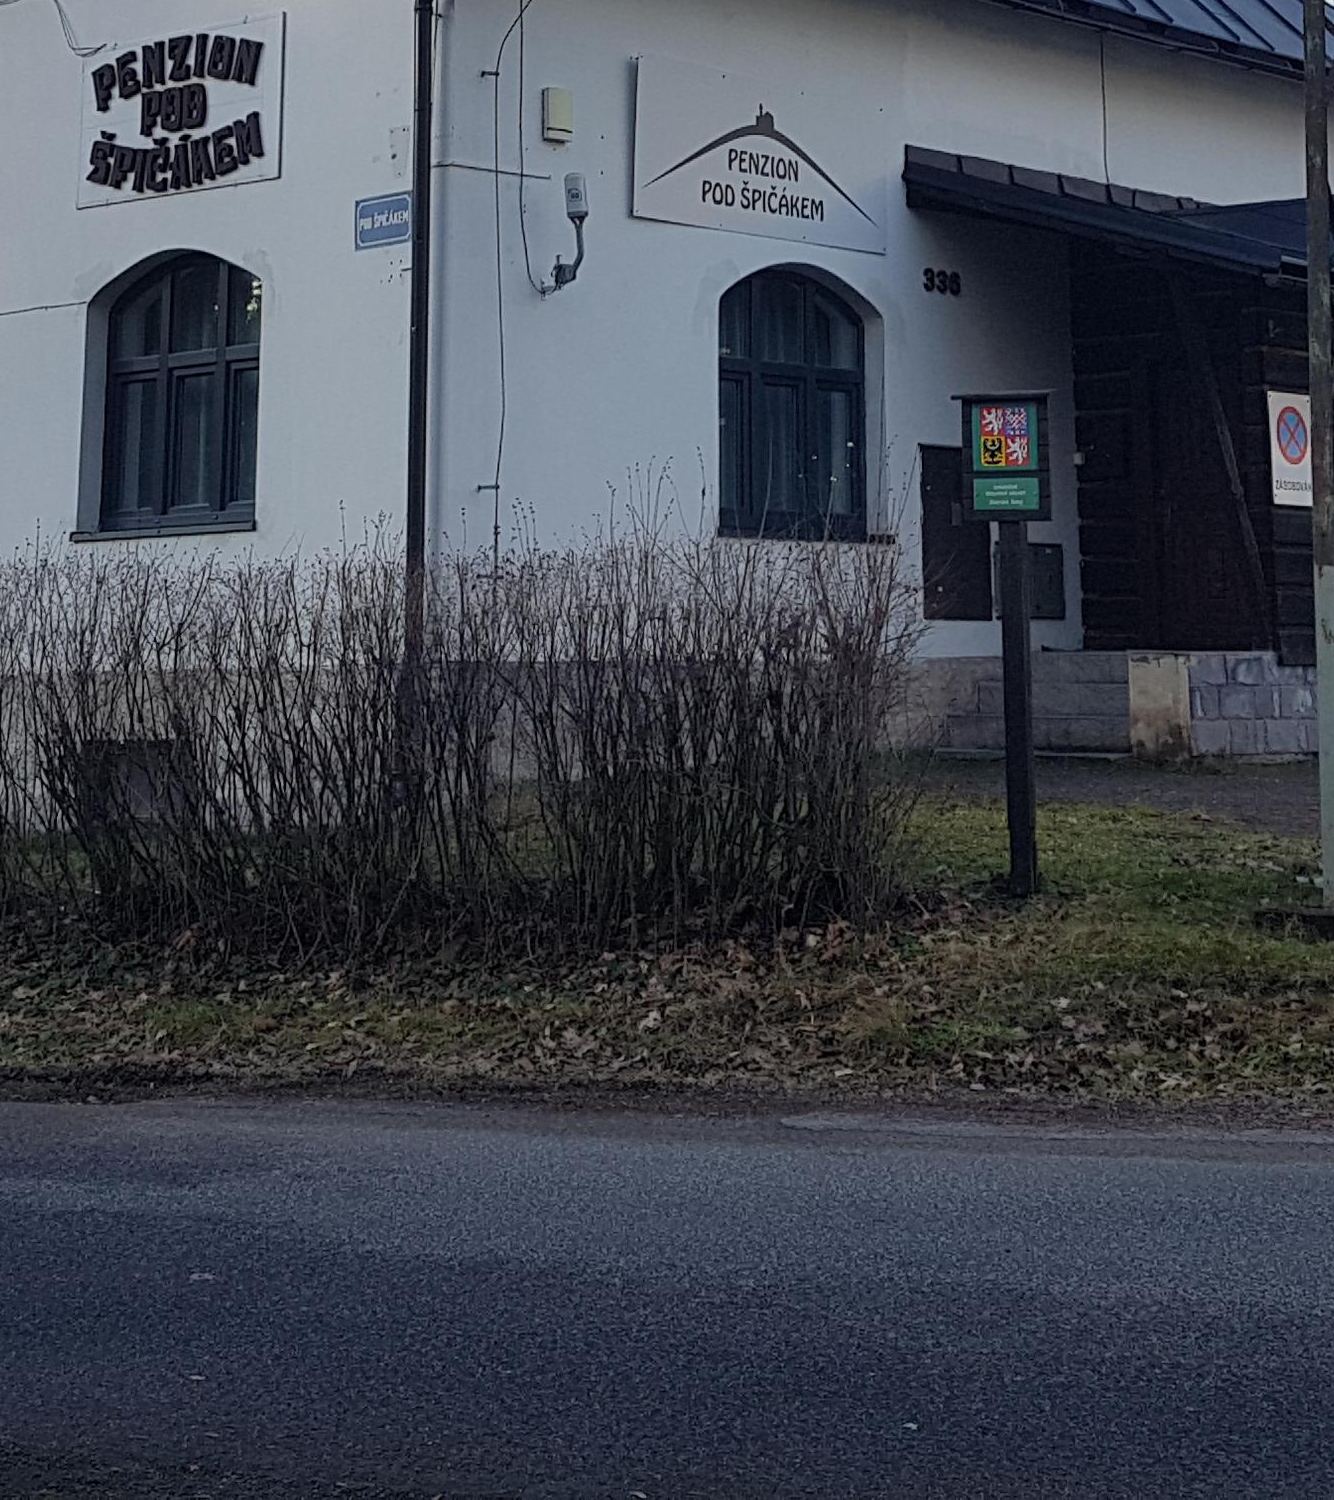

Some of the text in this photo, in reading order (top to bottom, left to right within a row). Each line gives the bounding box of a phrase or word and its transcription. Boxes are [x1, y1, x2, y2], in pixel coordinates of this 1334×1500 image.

[91, 33, 264, 113] PENZION
[139, 83, 207, 137] POD
[86, 110, 265, 194] ŠPIČÁKEM
[727, 148, 799, 182] PENZION
[373, 208, 409, 229] ŠPIČÁKEM
[701, 180, 825, 222] POD ŠPIČÁKEM
[1275, 478, 1312, 492] ZÁSOBOVÁN
